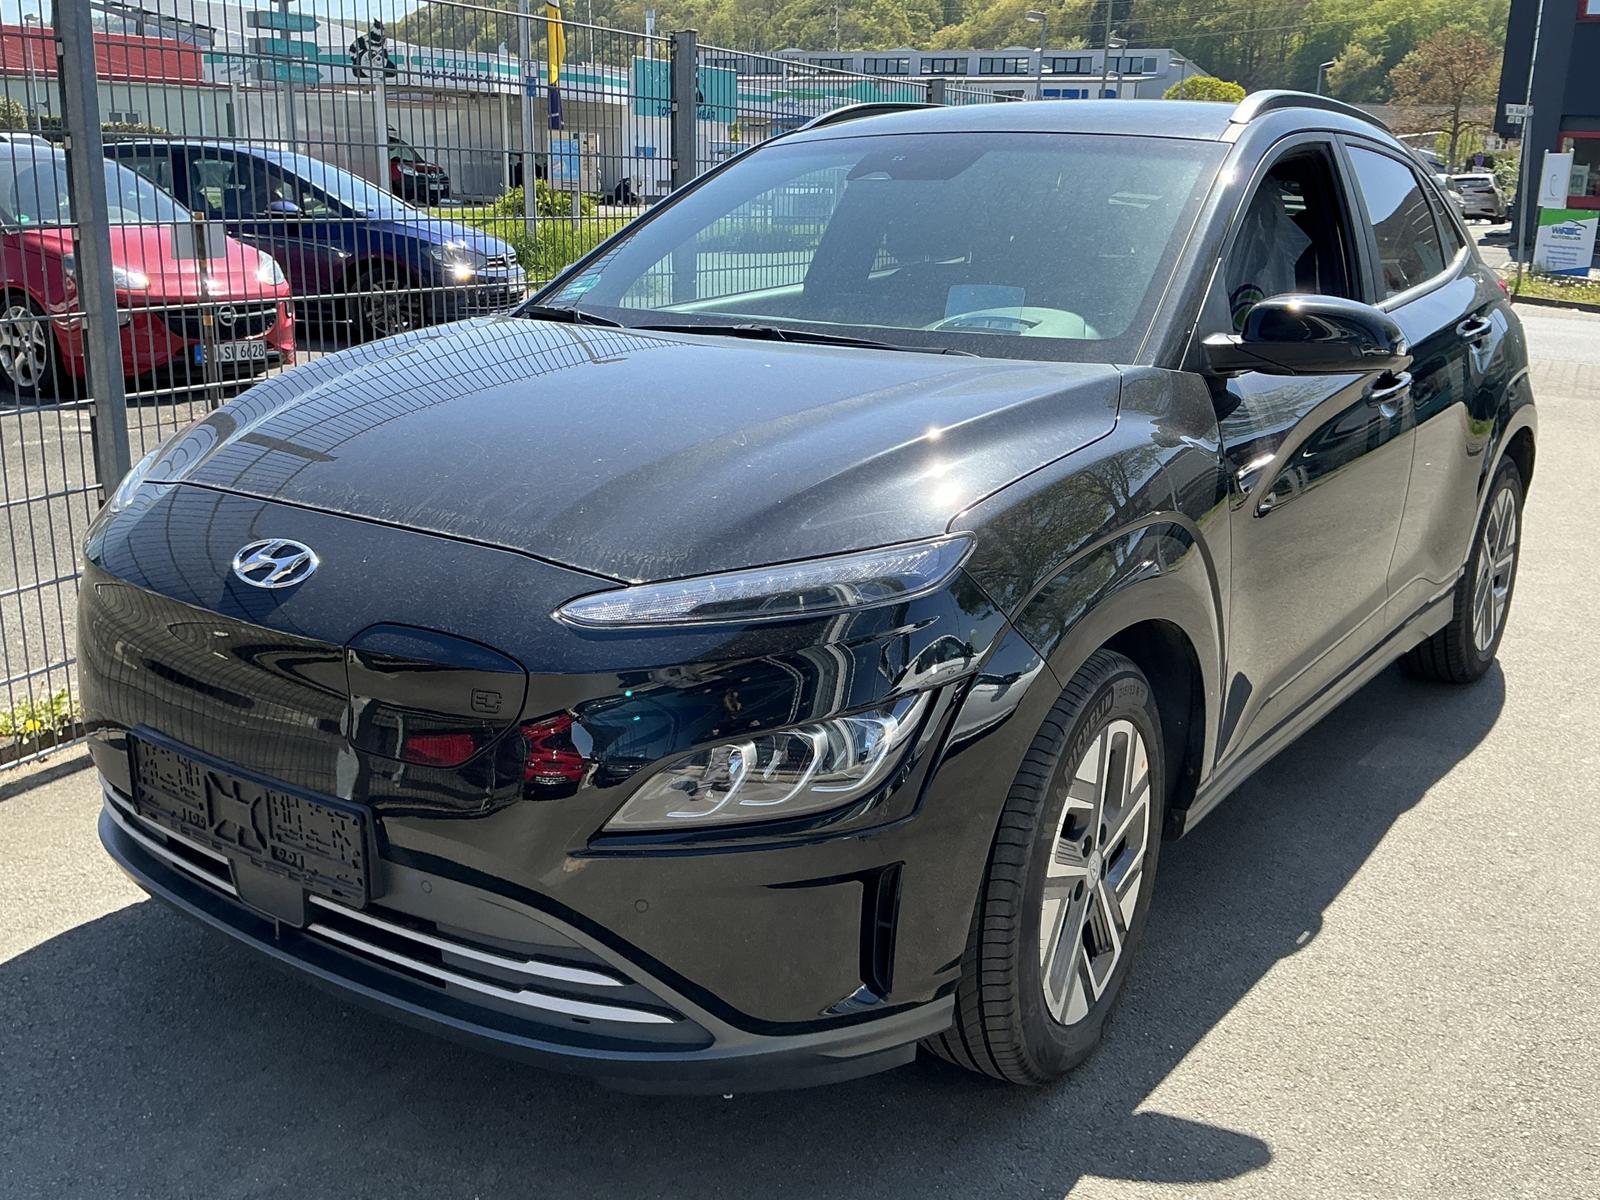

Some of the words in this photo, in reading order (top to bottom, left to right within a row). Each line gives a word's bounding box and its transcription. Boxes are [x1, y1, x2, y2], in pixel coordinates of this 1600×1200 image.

[423, 58, 438, 66] DIE
[240, 343, 265, 358] 6628
[1063, 687, 1114, 787] MICHELIN
